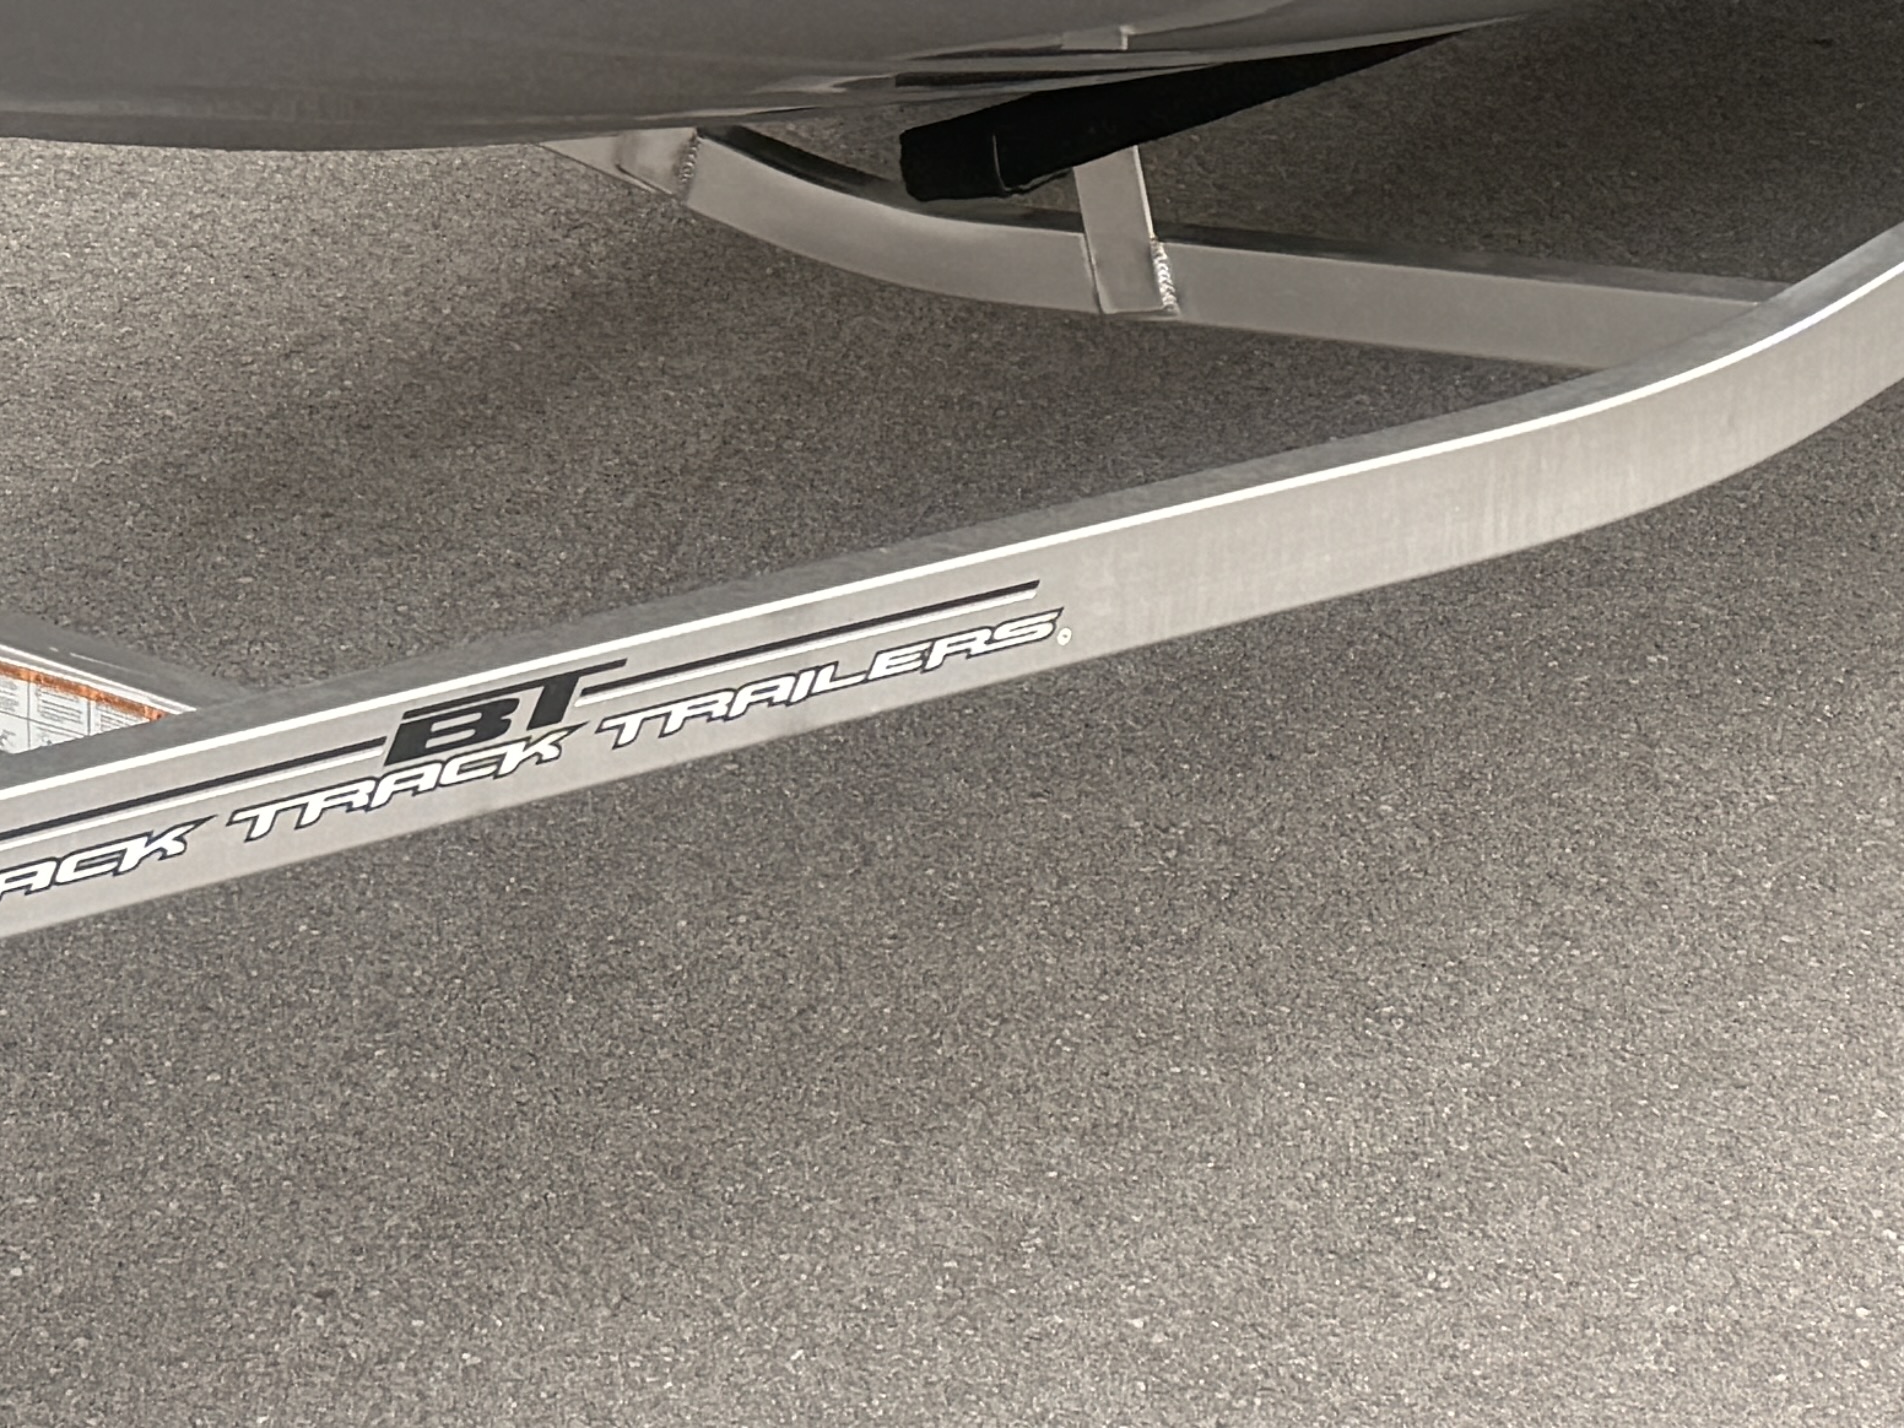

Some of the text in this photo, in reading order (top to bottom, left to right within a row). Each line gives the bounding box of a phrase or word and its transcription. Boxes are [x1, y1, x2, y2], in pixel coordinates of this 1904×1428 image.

[227, 721, 589, 842] TRACK
[595, 607, 1065, 750] TRAILERS
[383, 658, 628, 767] BT
